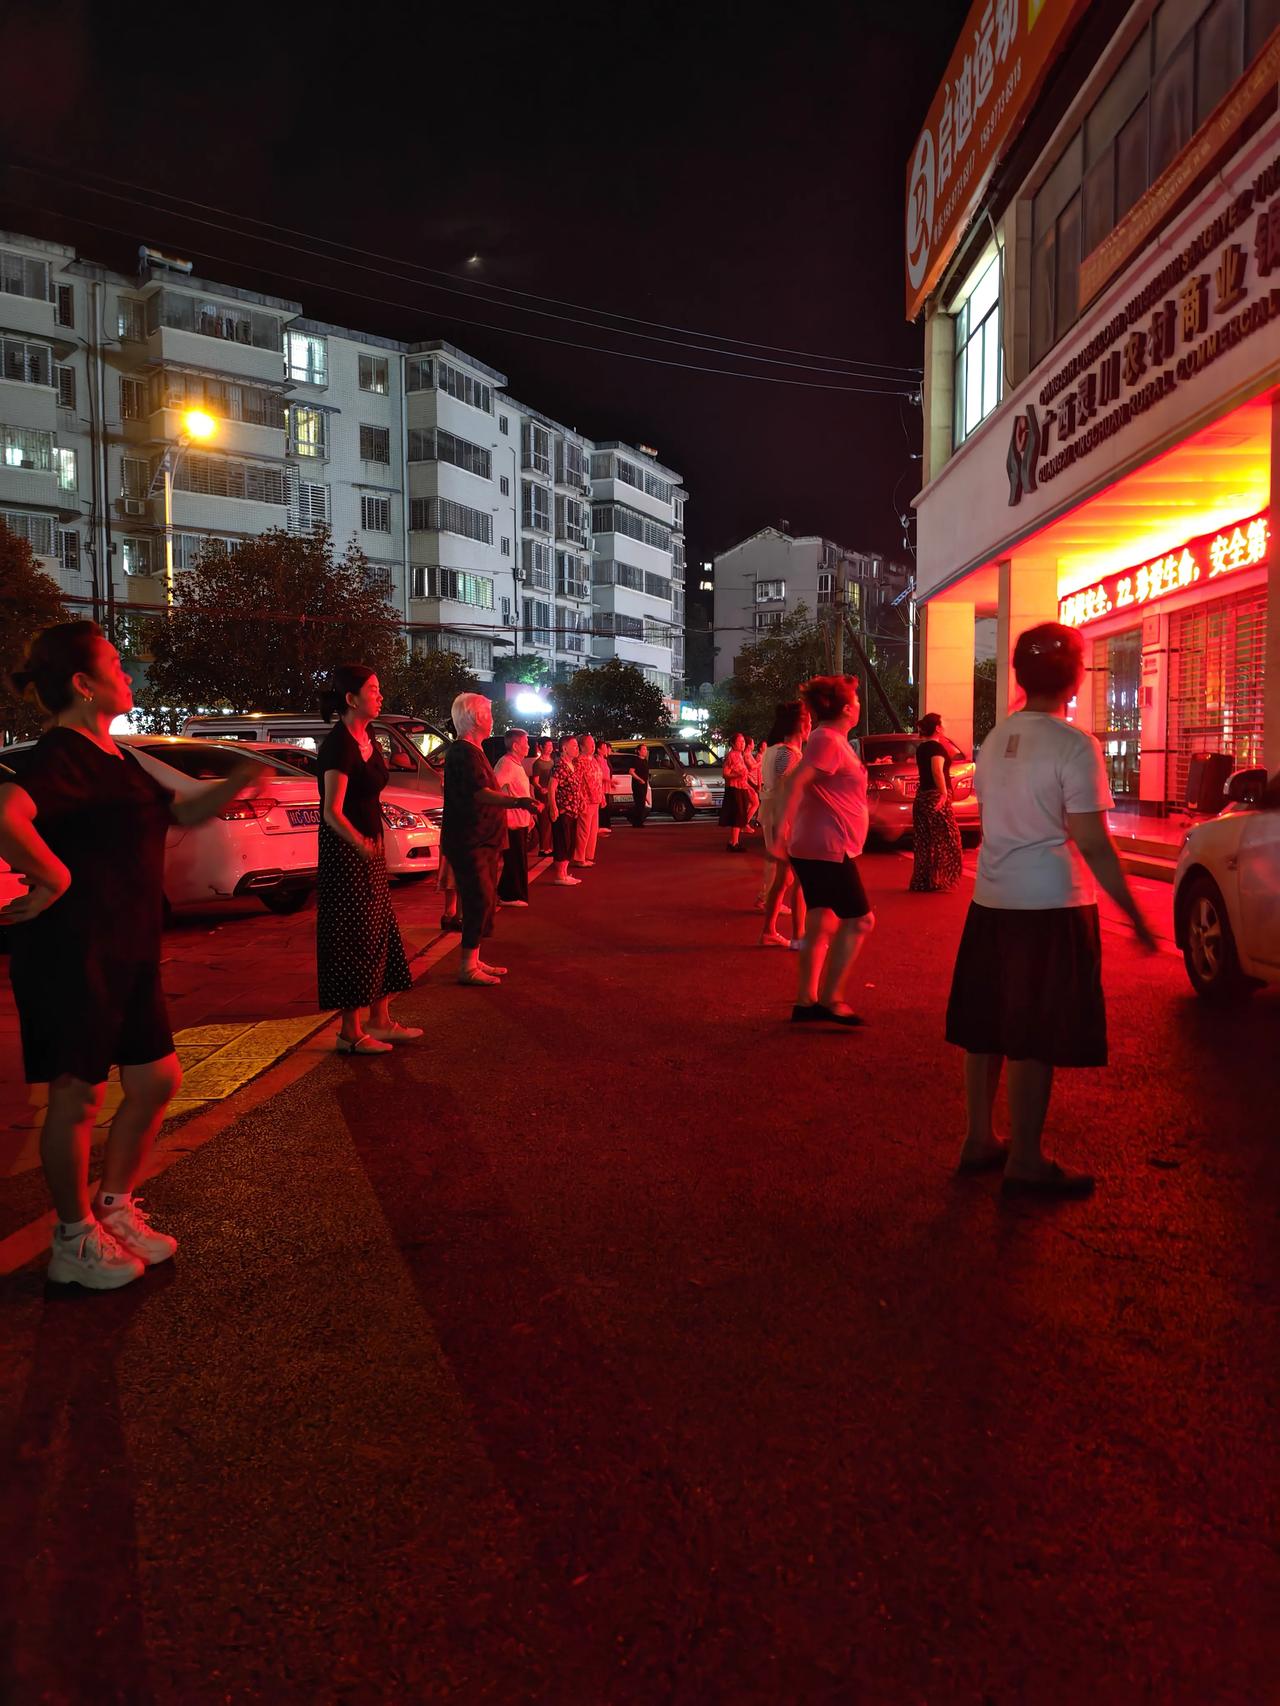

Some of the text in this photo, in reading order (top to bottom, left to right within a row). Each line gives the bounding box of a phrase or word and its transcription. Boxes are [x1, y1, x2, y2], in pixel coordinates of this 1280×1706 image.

[1039, 289, 1280, 483] GUANGXI LINGCHUAN RURAL COMMERCIAL
